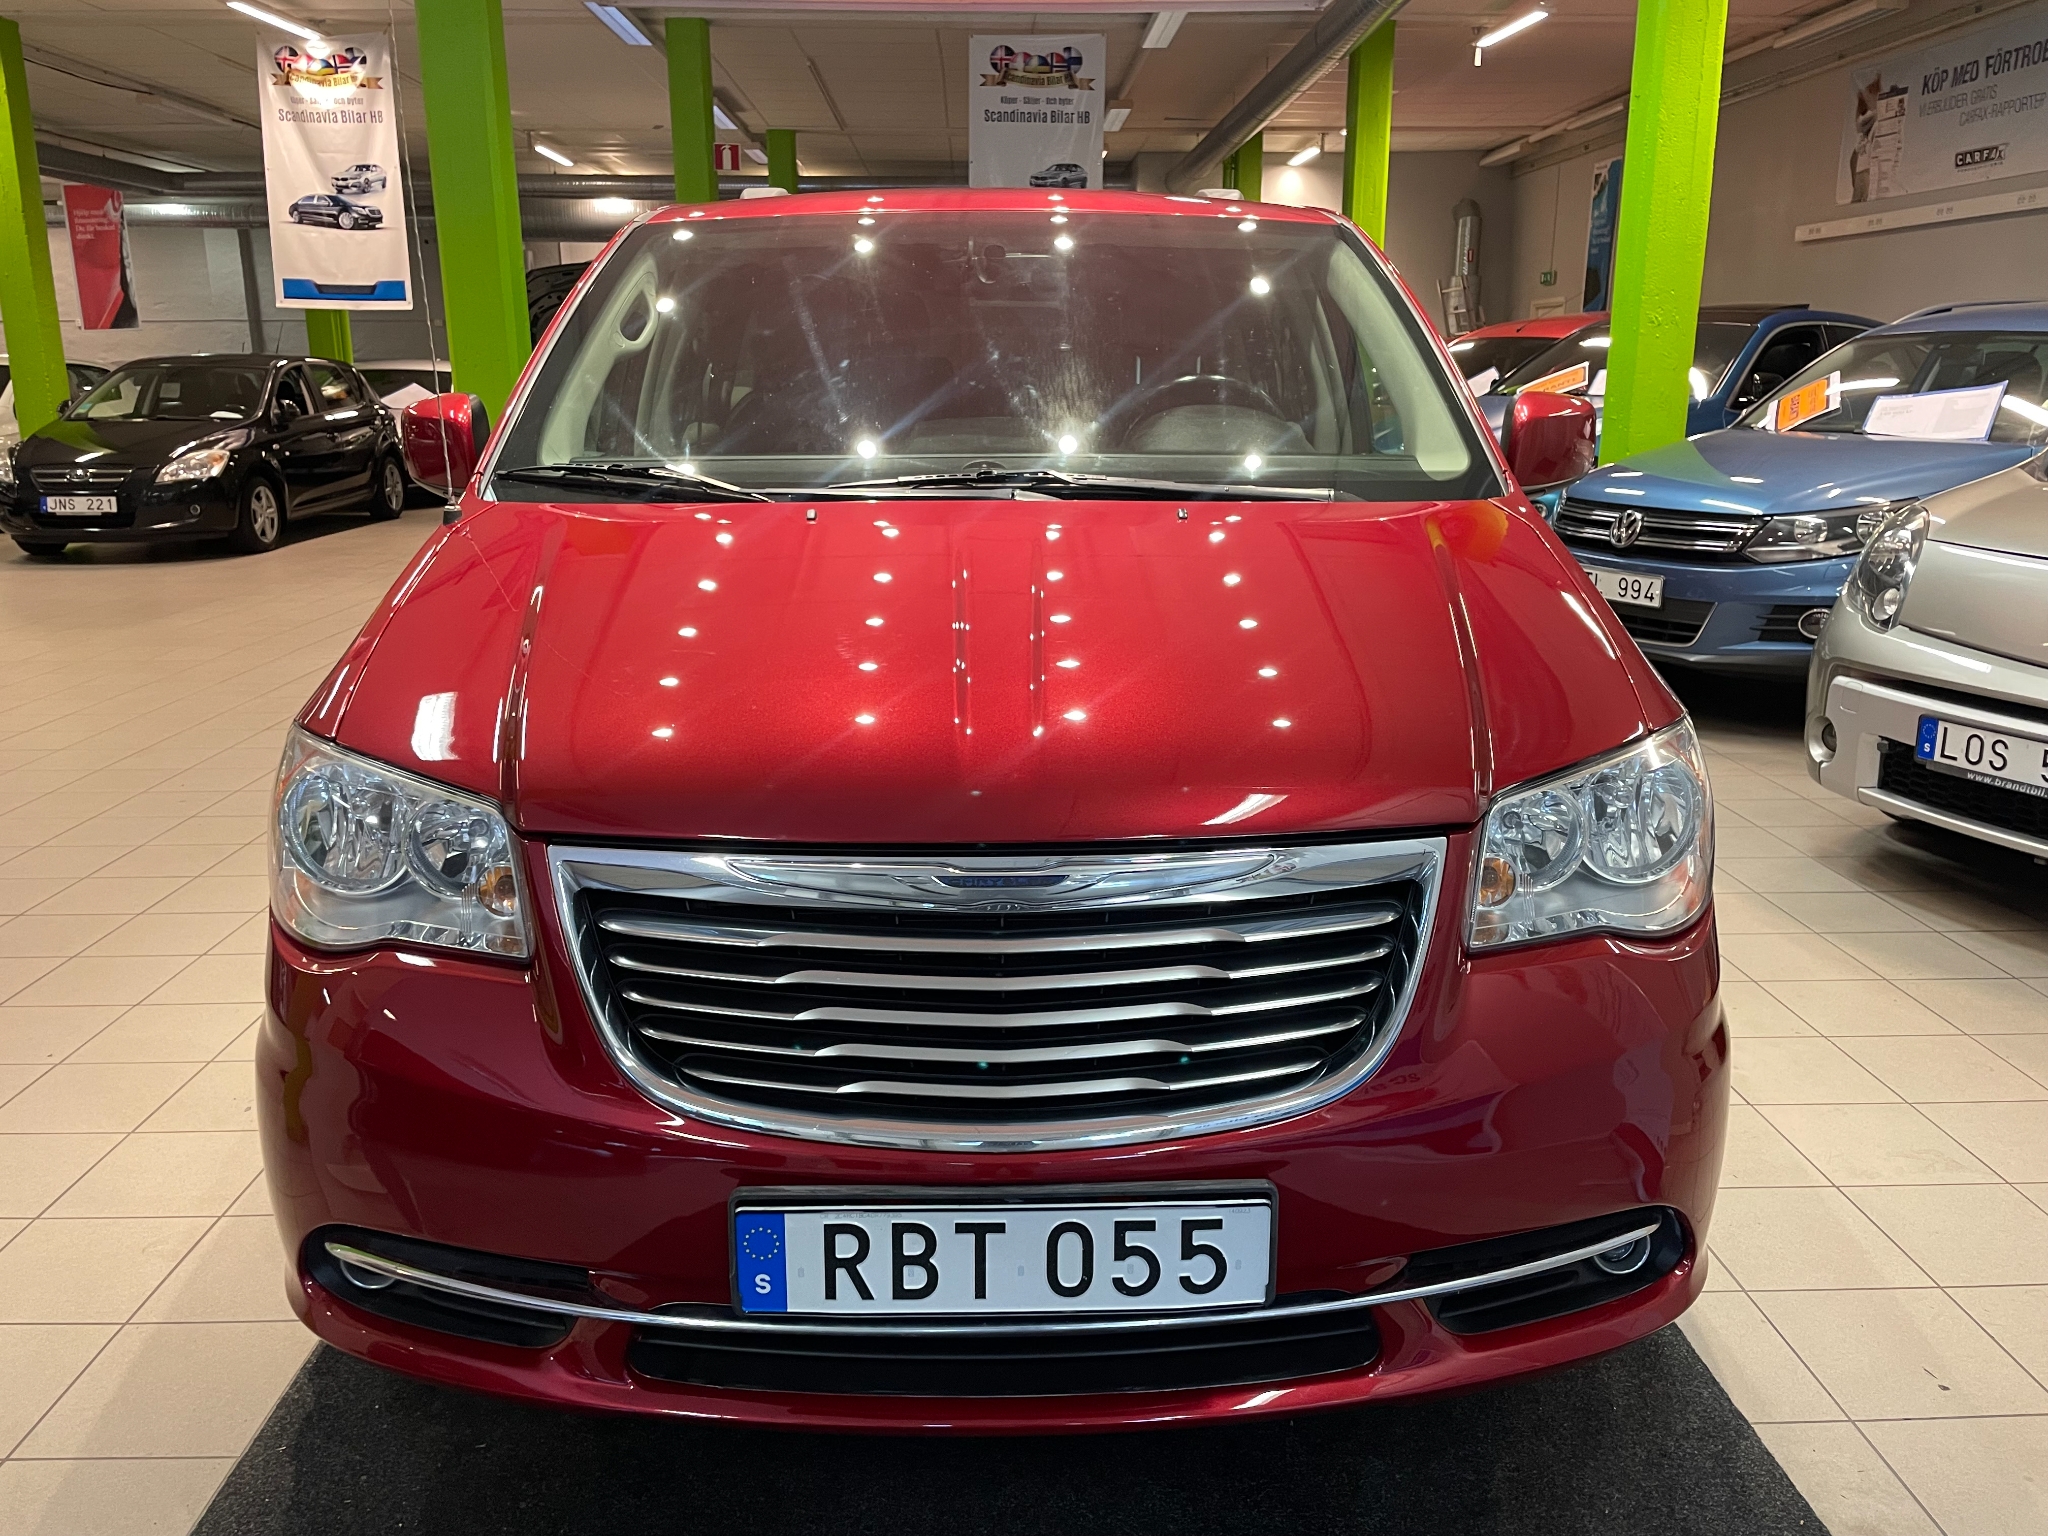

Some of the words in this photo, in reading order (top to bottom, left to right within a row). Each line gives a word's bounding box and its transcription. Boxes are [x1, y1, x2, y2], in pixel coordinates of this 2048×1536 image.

[1921, 66, 1949, 96] KÖP
[1951, 60, 1979, 87] MED
[278, 108, 338, 124] Scandinavia
[341, 110, 367, 124] Bilar
[369, 110, 384, 124] HB
[984, 108, 1048, 124] Scandinavia
[1050, 109, 1075, 124] Bilar
[1077, 110, 1091, 124] HB
[49, 498, 76, 511] JNS
[86, 498, 112, 511] 221
[1617, 576, 1655, 602] 994
[1923, 743, 1931, 752] S
[1940, 726, 2009, 772] LOS
[823, 1222, 1006, 1300] RBT
[1046, 1218, 1228, 1297] 055
[755, 1273, 771, 1294] S
